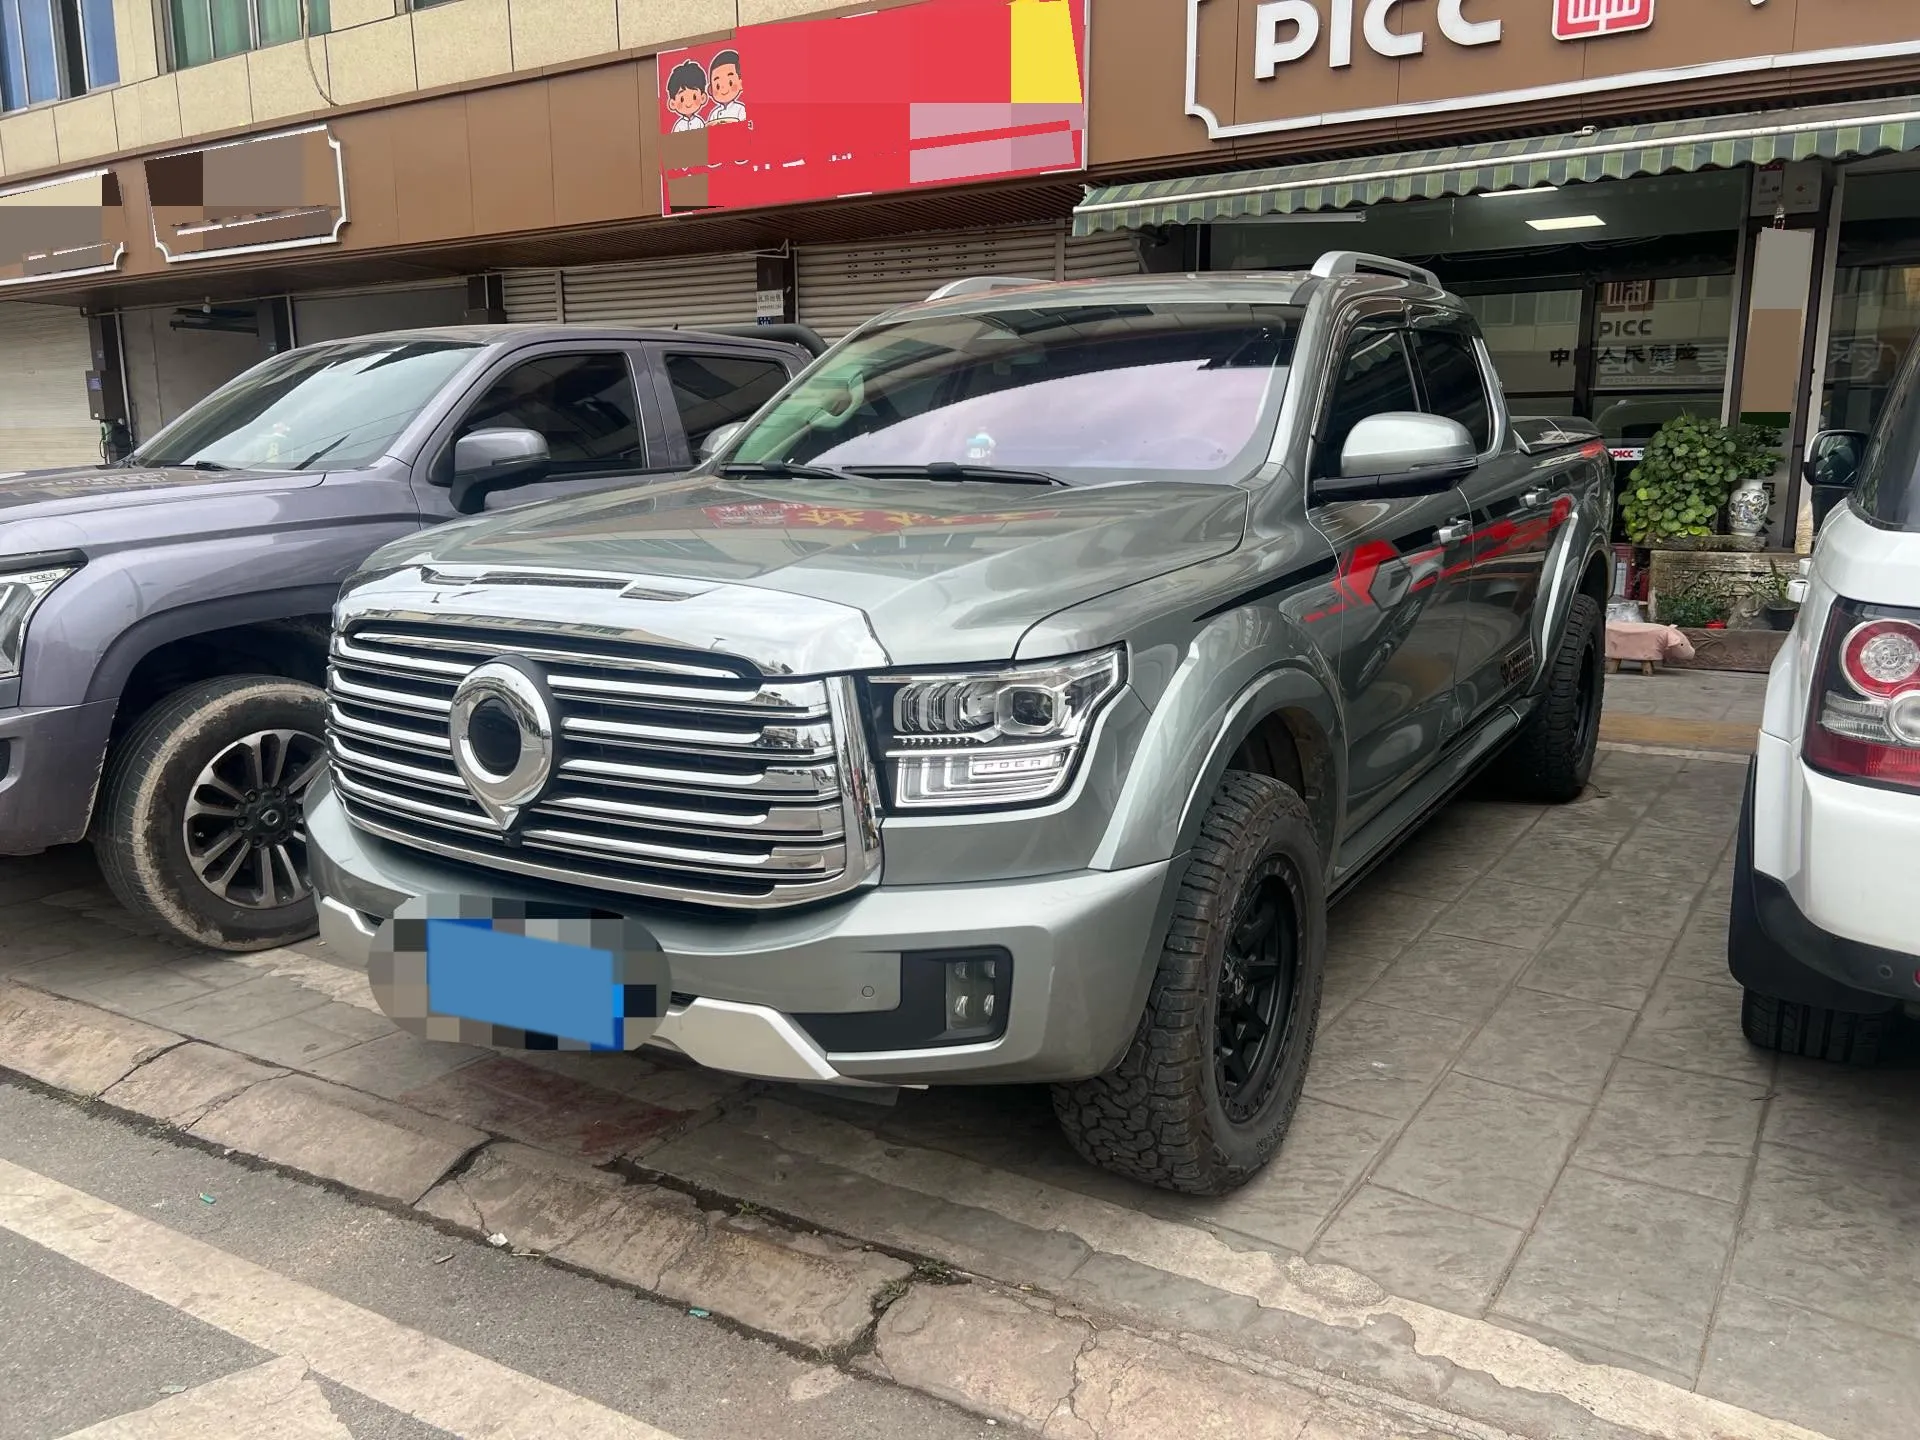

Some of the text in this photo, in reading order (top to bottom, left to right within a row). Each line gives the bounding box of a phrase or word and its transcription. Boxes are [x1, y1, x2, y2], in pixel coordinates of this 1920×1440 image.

[1255, 0, 1501, 79] PICC
[1600, 319, 1652, 337] PICC
[1551, 343, 1698, 368] 中人民保险
[1613, 450, 1633, 458] PICC
